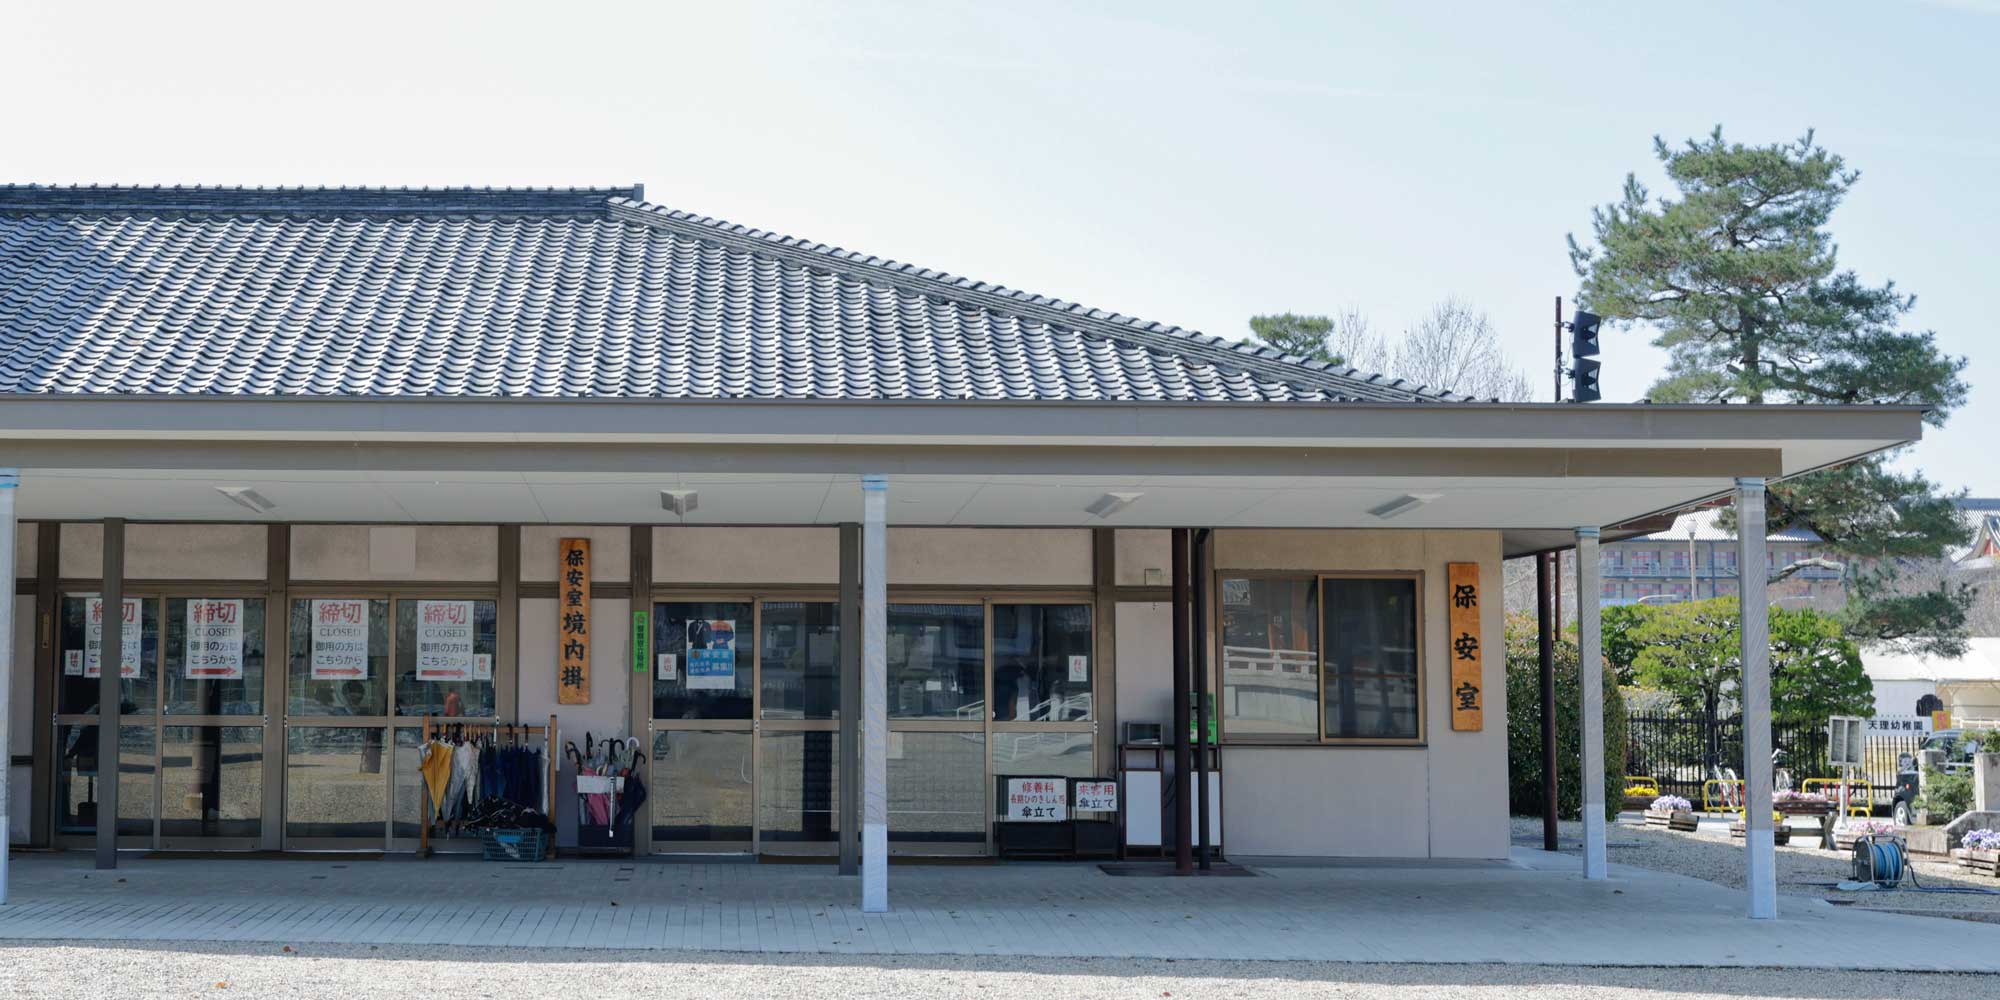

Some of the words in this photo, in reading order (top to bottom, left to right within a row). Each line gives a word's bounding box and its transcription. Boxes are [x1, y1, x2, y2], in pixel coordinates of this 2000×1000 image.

[193, 602, 237, 624] 締切
[319, 602, 362, 624] 締切
[424, 603, 467, 625] 締切
[560, 548, 588, 690] 保安室境内掛
[320, 628, 361, 637] CLOSED
[424, 629, 467, 638] CLOSED
[316, 641, 364, 652] 御用の方は
[421, 642, 470, 653] 御用の方は
[1453, 584, 1481, 712] 保安室
[192, 655, 238, 665] こちらから
[316, 656, 362, 665] こちらから
[422, 656, 468, 666] こちらから
[1868, 720, 1924, 731] 天理幼稚園
[1022, 781, 1055, 793] 修養科
[1079, 784, 1115, 795] 来客用
[1079, 797, 1115, 809] 傘立て
[1022, 806, 1056, 819] 傘立て
